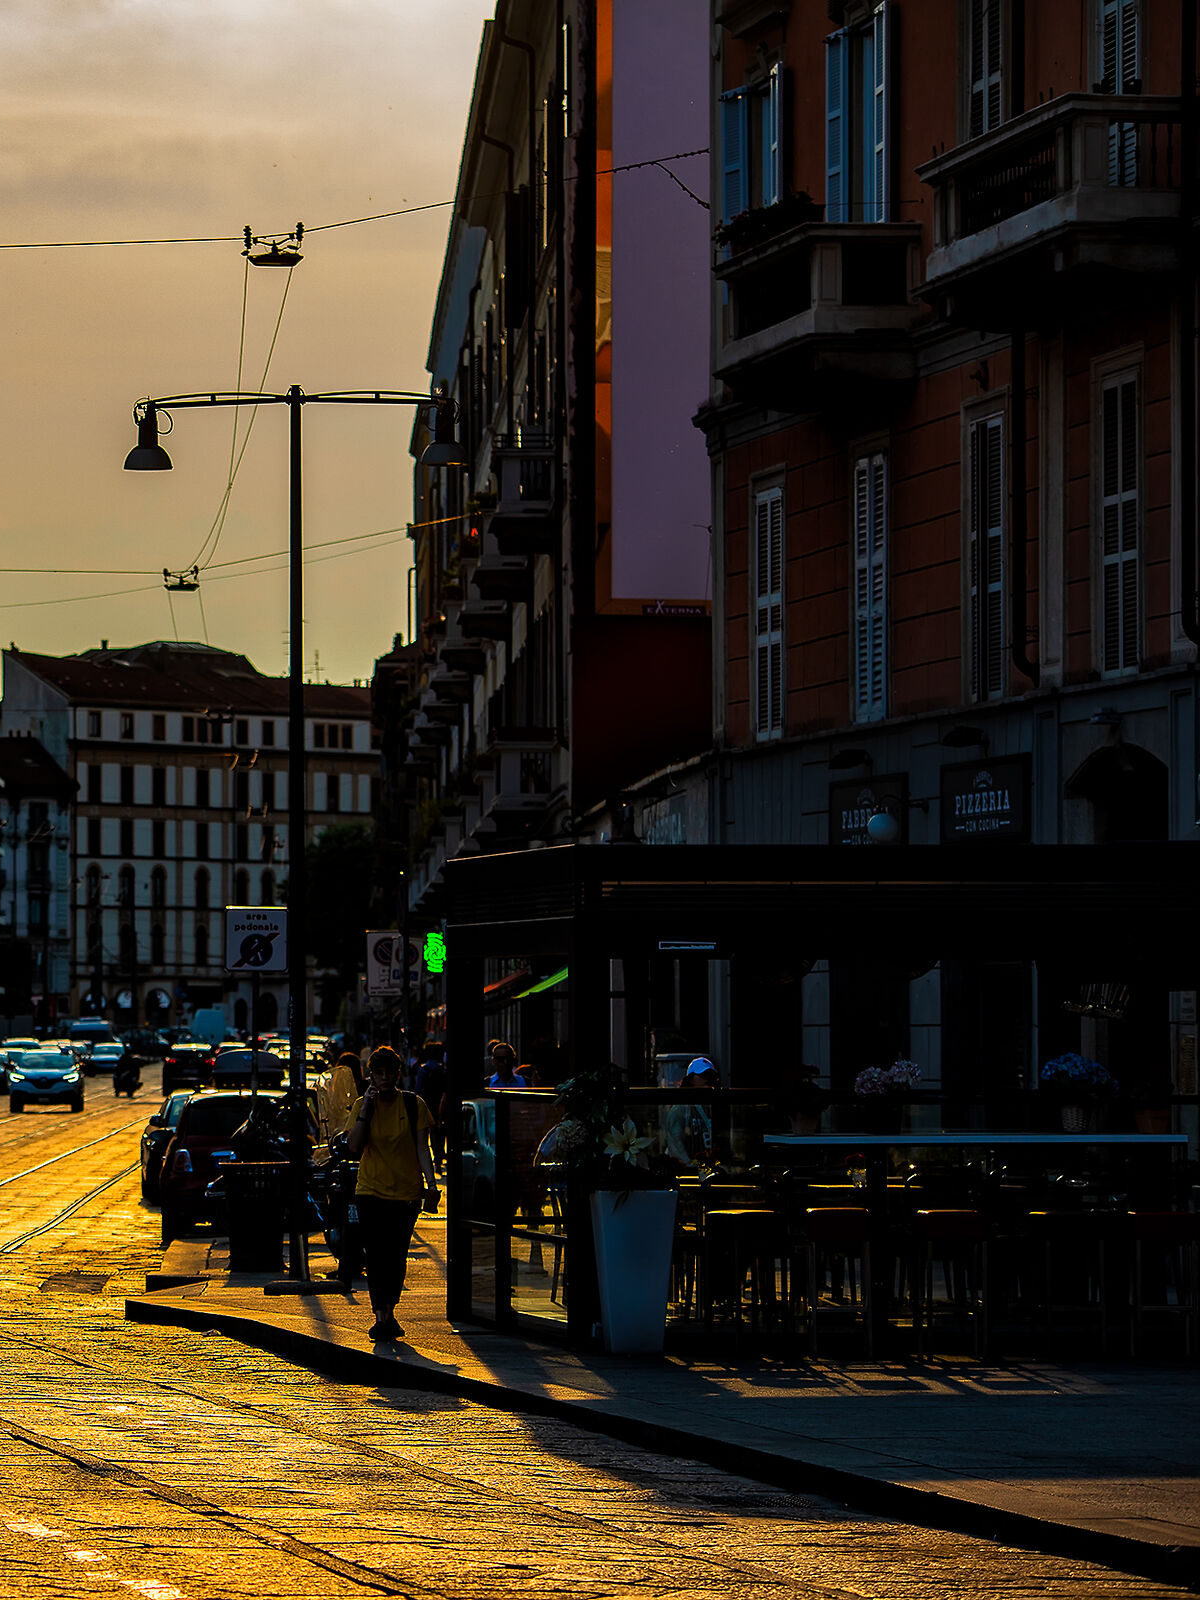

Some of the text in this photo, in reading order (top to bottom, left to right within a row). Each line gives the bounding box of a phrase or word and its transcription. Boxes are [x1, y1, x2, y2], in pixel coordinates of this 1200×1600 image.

[954, 789, 1011, 816] PIZZERIA
[246, 913, 268, 921] area
[234, 923, 279, 932] pedonale
